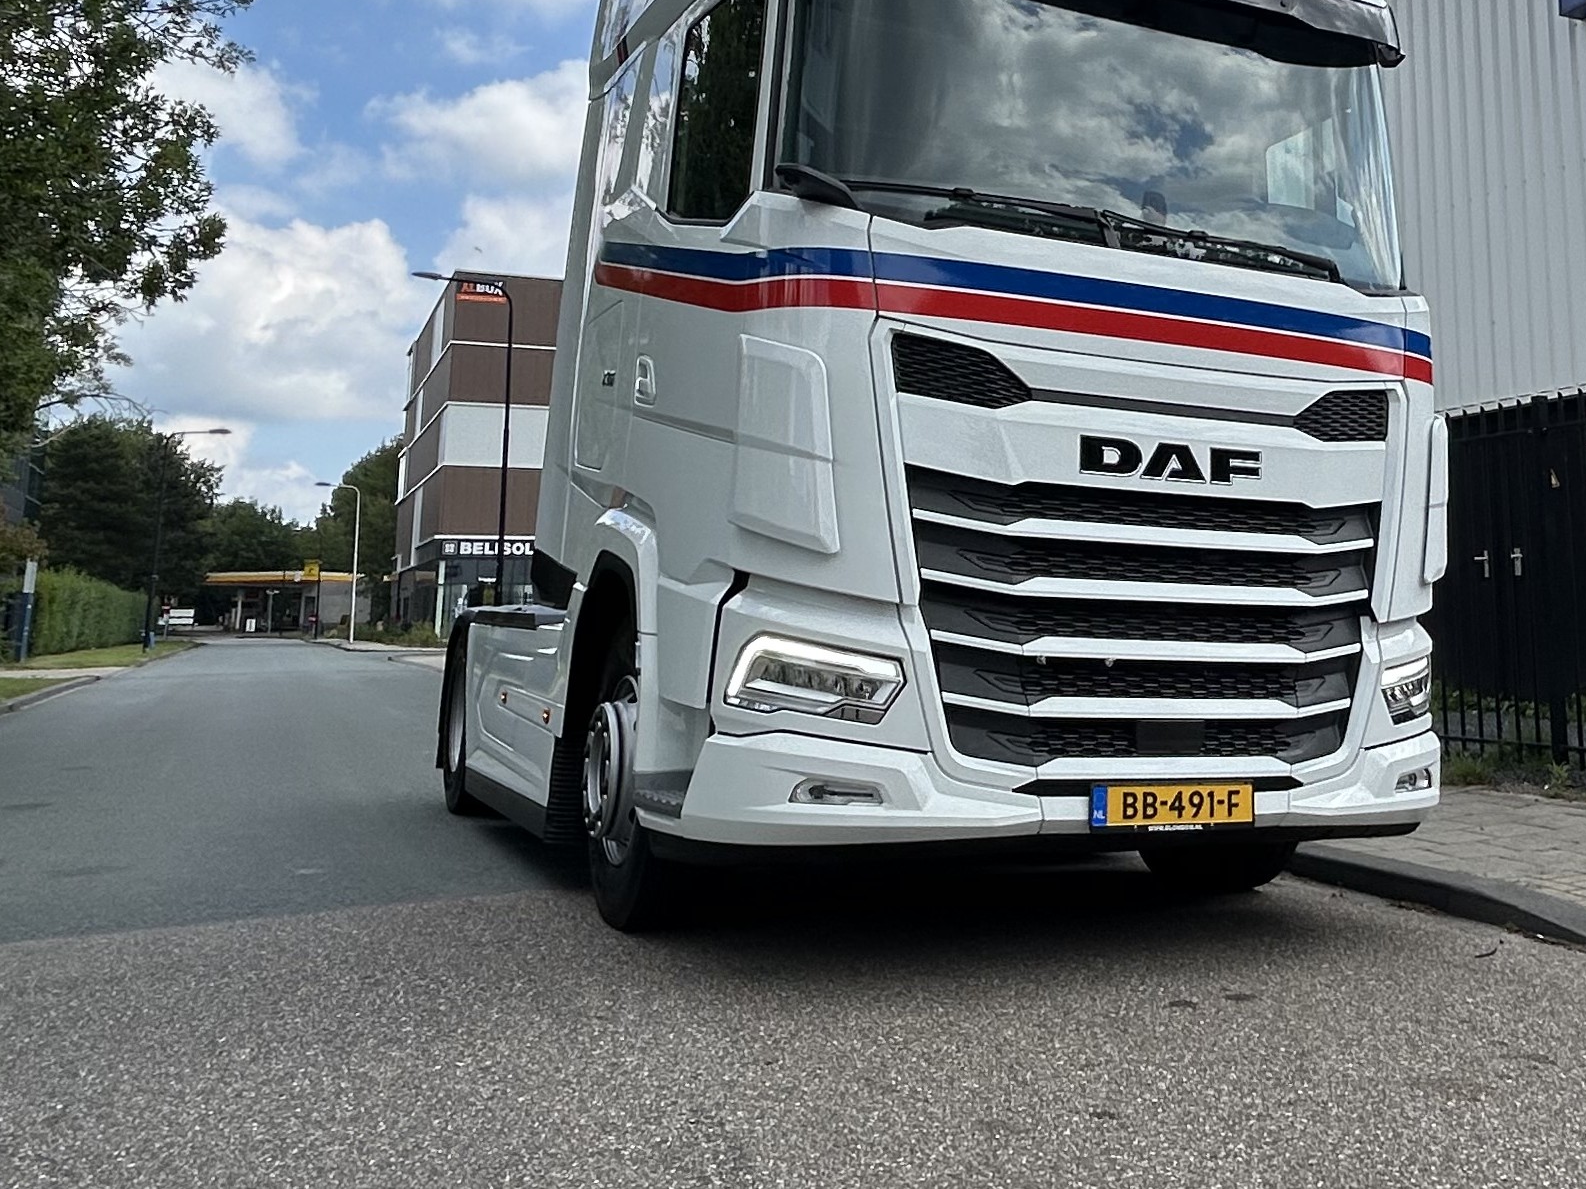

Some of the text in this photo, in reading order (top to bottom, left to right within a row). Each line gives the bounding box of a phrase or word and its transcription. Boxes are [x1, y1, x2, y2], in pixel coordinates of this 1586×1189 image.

[1079, 434, 1263, 486] DAF
[459, 541, 534, 556] BELISOL
[1092, 810, 1106, 820] NL
[1122, 789, 1241, 820] BB-491-F
